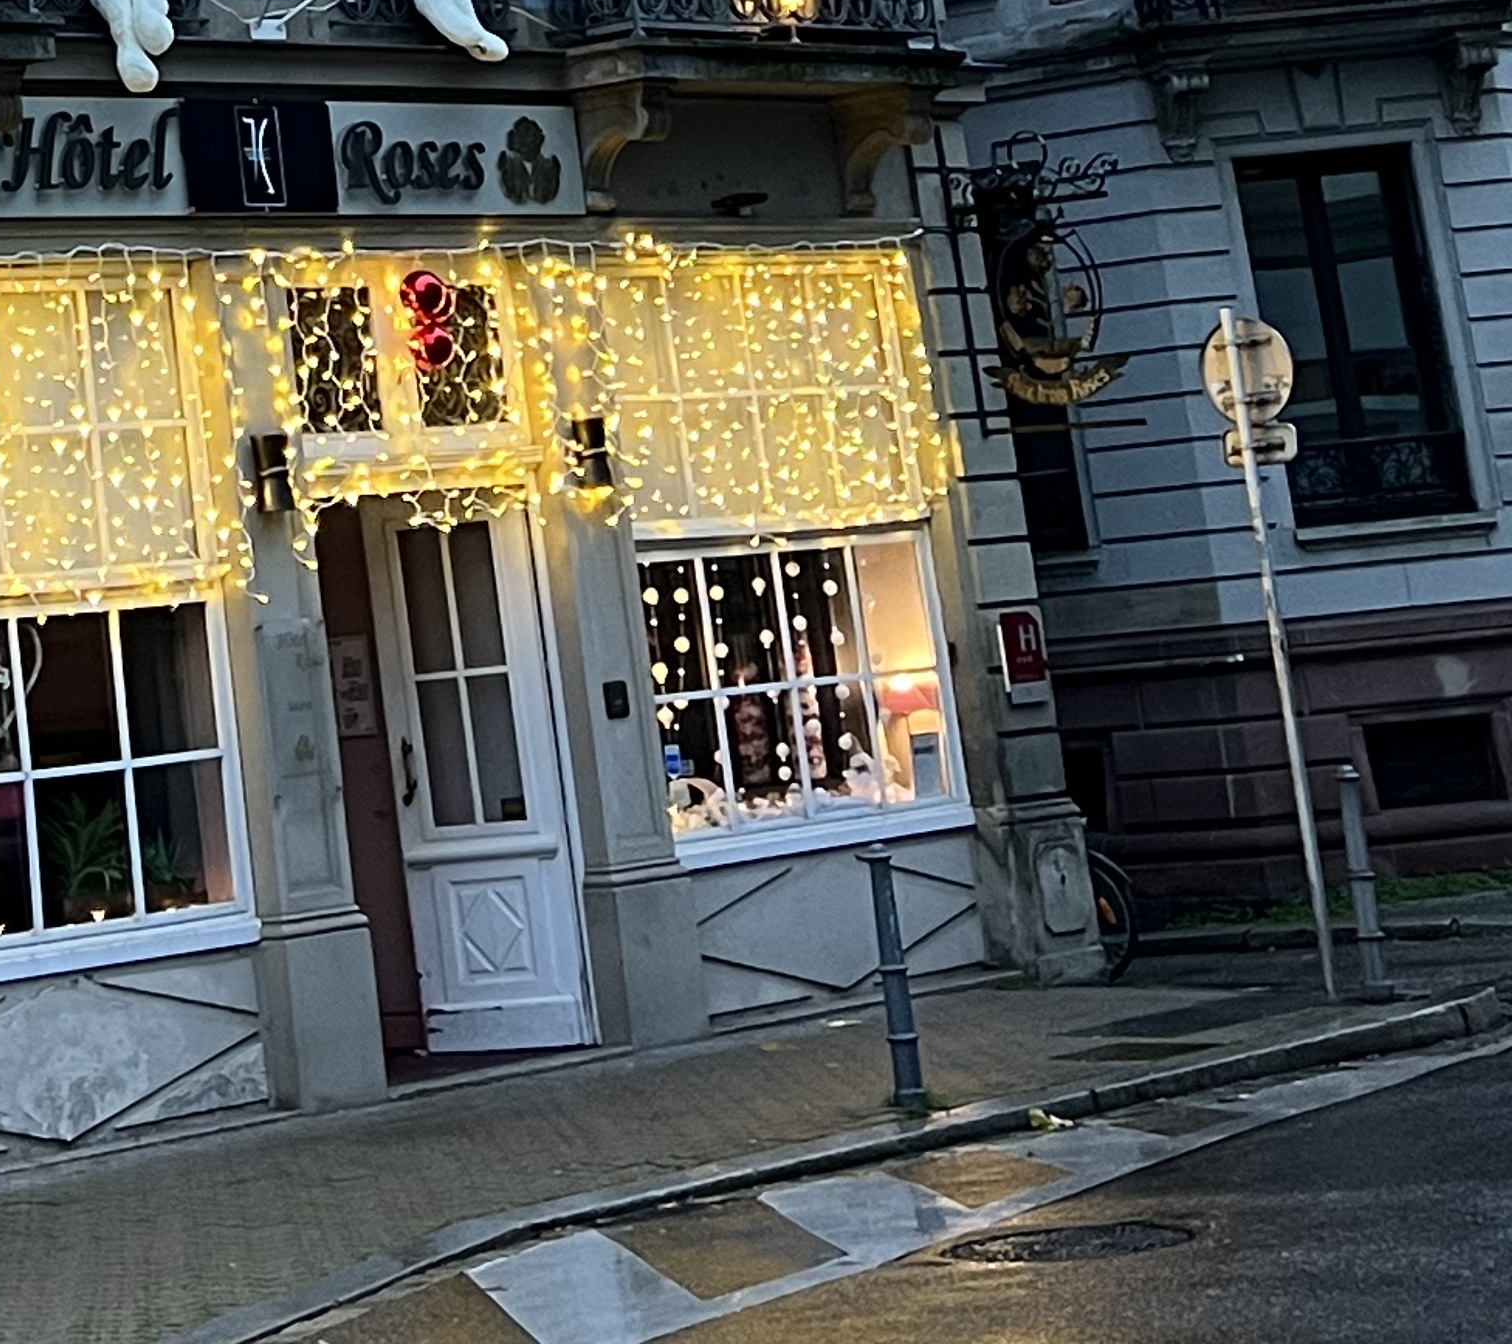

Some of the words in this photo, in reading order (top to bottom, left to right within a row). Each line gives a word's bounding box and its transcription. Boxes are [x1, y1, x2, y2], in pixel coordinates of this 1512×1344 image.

[0, 108, 180, 192] Hôtel
[339, 120, 486, 205] Roses
[1018, 623, 1037, 652] H
